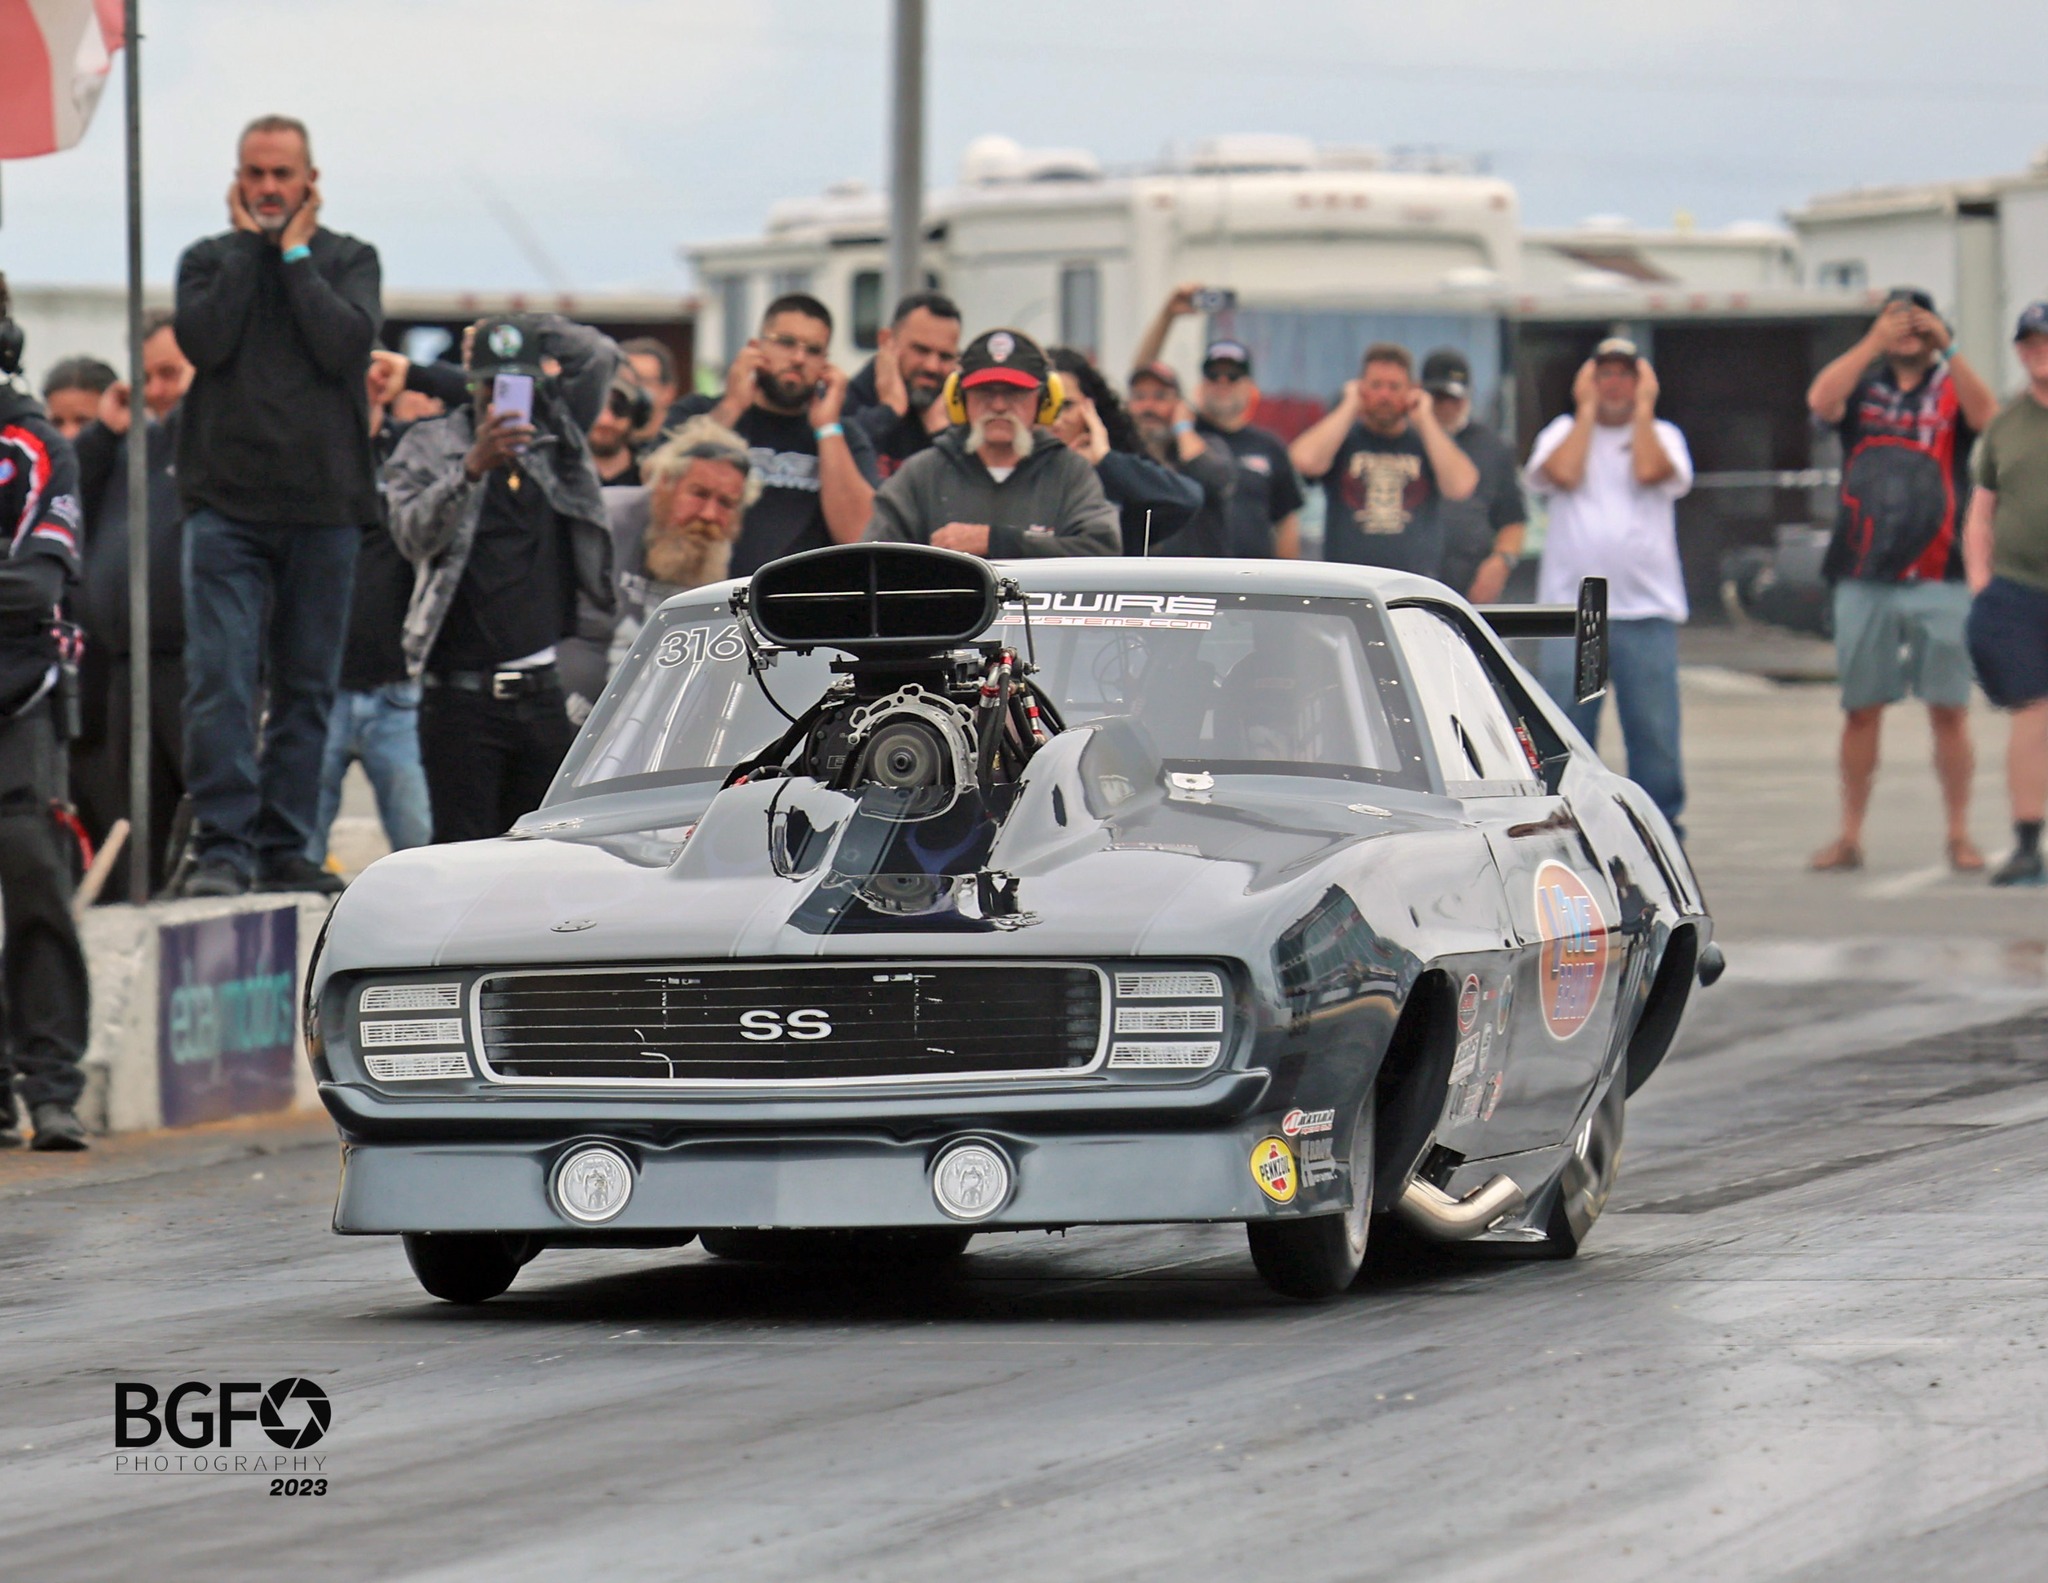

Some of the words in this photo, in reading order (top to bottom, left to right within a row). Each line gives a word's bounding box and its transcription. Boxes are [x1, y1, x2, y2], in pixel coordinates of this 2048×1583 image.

[656, 624, 746, 668] 316
[740, 1009, 832, 1041] SS
[1259, 1156, 1290, 1183] PENNZOIL
